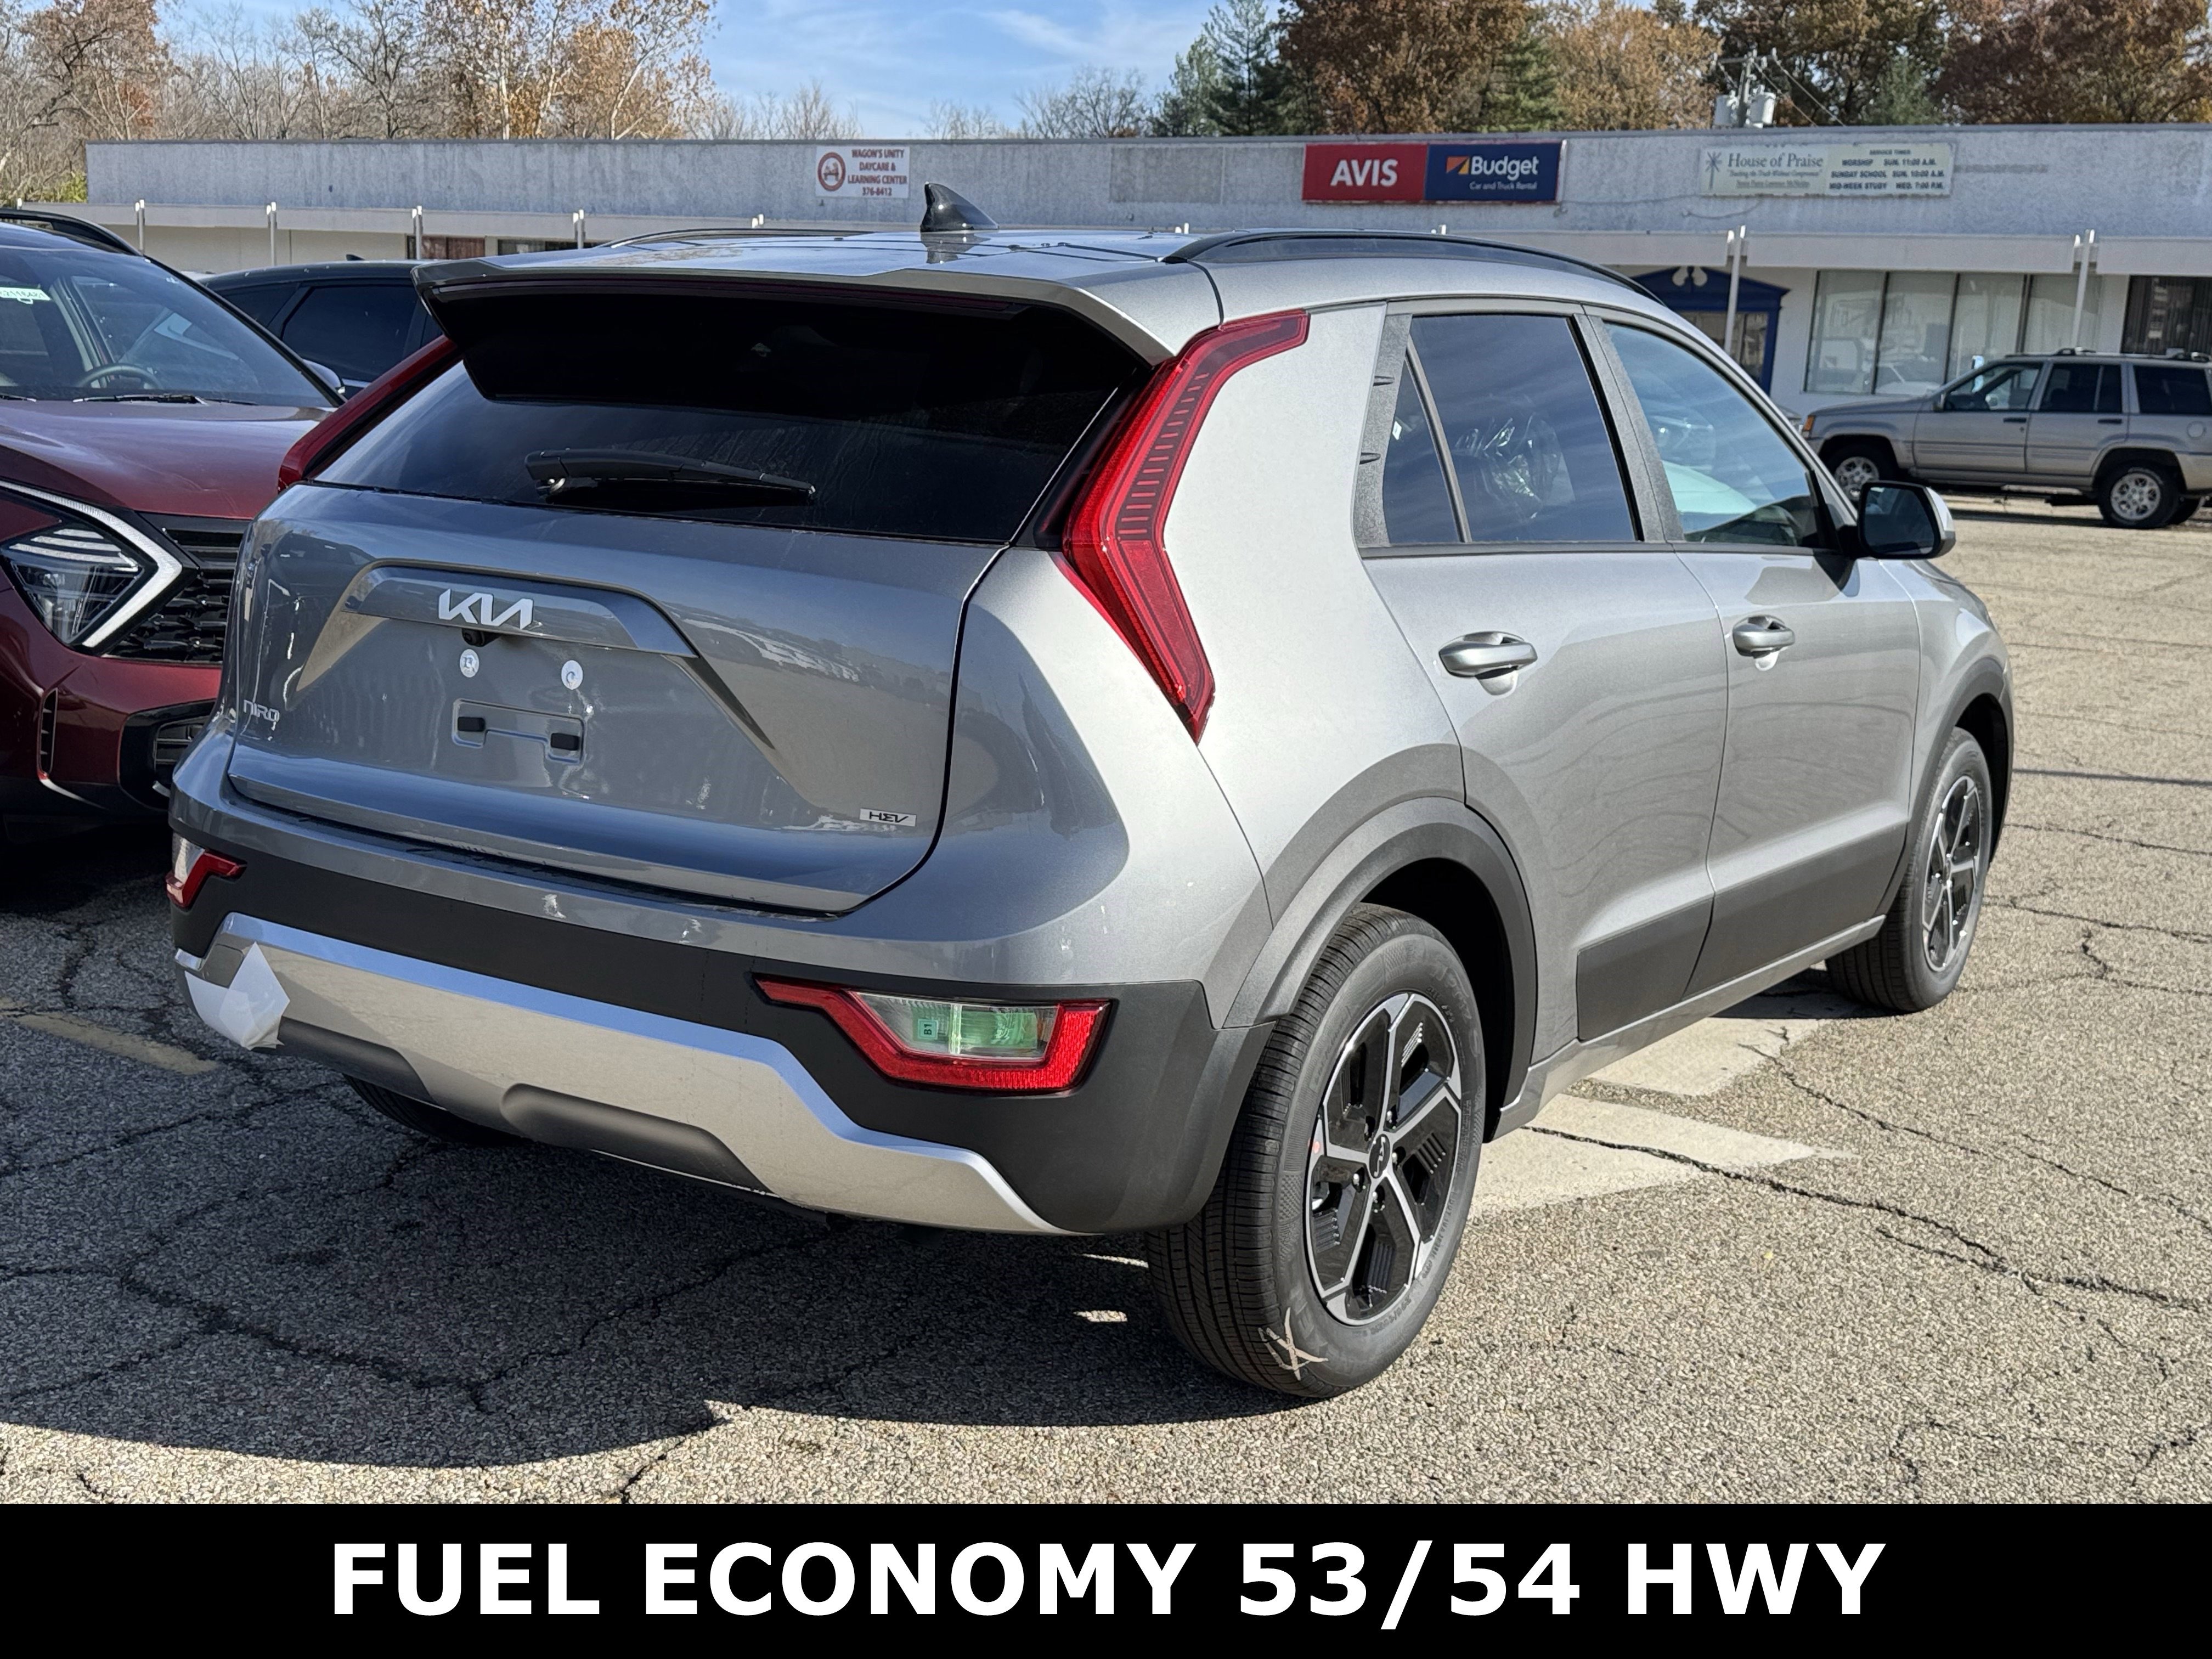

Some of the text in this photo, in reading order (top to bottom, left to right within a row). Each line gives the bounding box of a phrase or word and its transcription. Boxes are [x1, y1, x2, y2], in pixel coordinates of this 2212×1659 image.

[884, 149, 905, 158] UNITY
[1728, 152, 1824, 167] House of Praise
[859, 162, 890, 171] DAYCARE
[1330, 158, 1398, 187] AVIS
[1471, 155, 1539, 180] Budget
[848, 174, 908, 185] LEARNING CENTER
[1469, 181, 1482, 190] Car
[1483, 181, 1497, 190] and
[1516, 181, 1538, 190] Rental
[439, 588, 534, 630] KIA
[243, 699, 280, 723] NIRO
[869, 811, 909, 823] HEV
